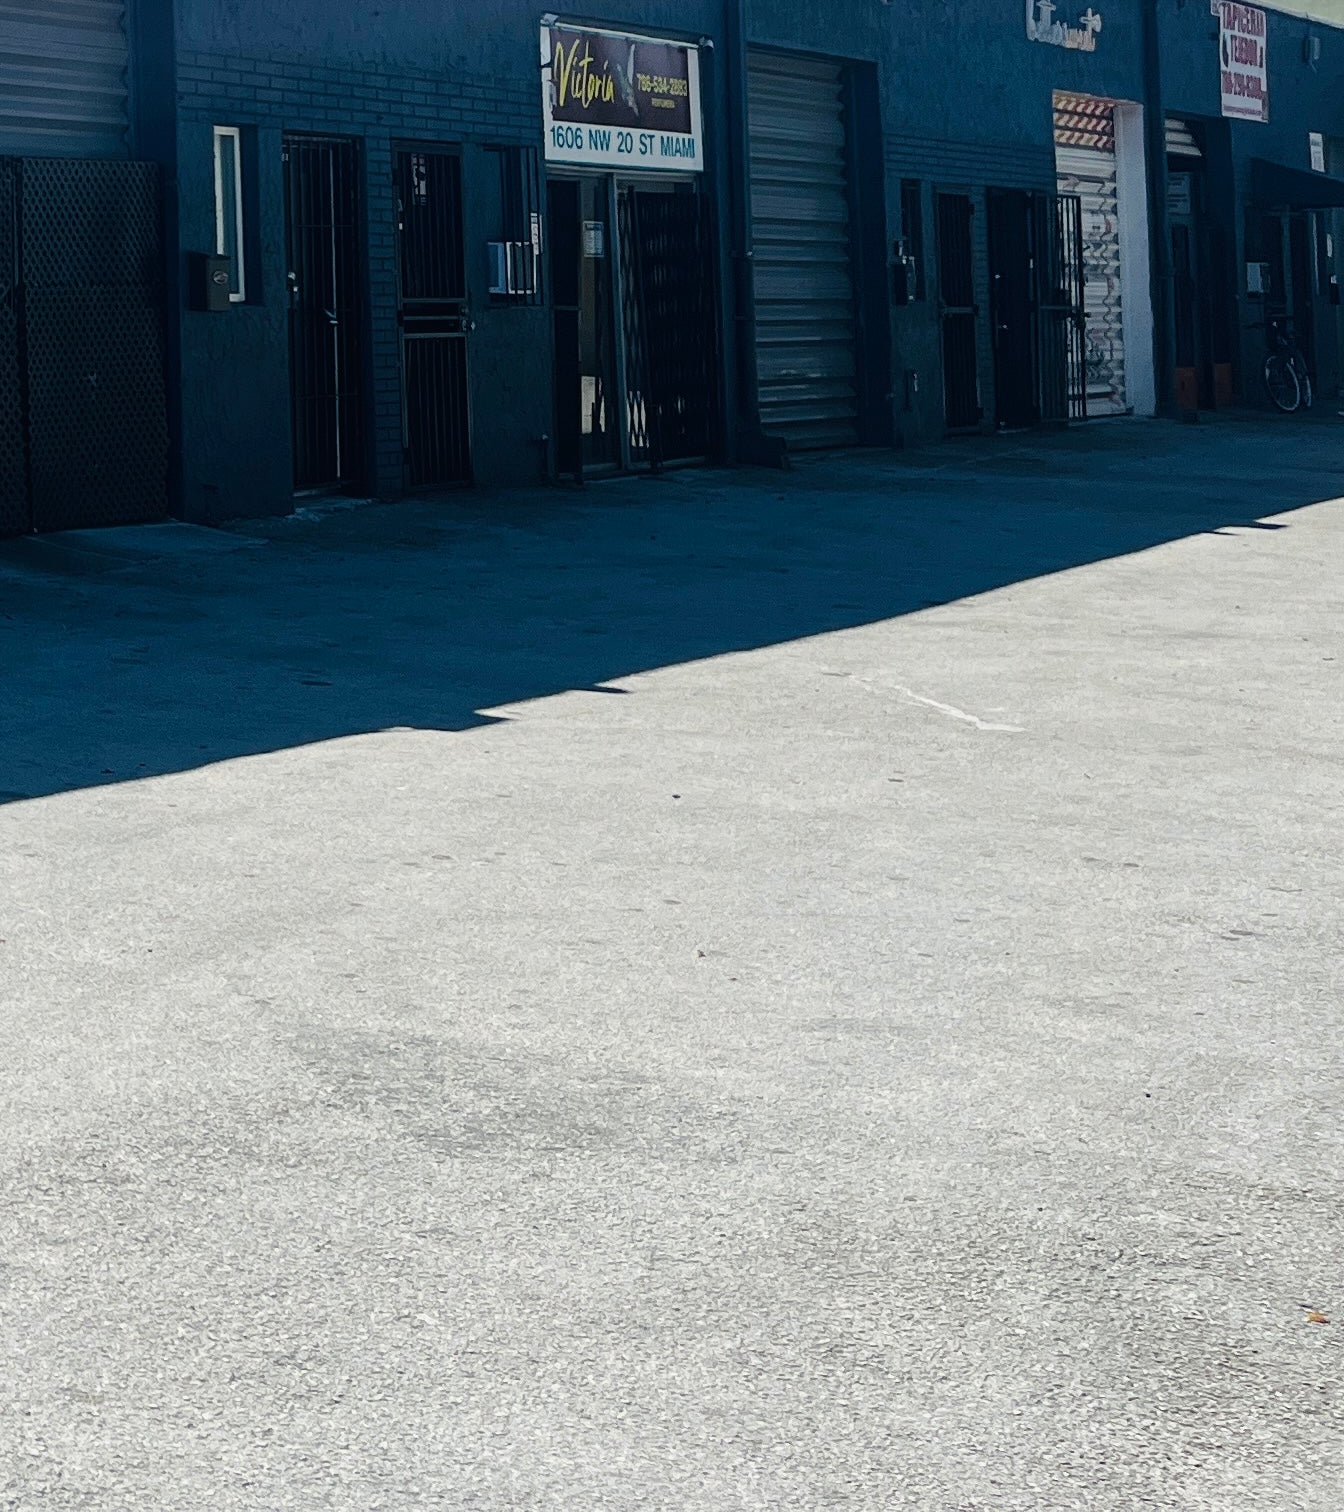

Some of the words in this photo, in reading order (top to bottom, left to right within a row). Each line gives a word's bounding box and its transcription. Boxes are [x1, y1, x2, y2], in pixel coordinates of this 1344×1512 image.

[554, 38, 615, 108] Victoria
[551, 125, 584, 149] 1606
[588, 129, 612, 152] NW
[617, 131, 633, 154] 20
[639, 133, 656, 156] ST
[660, 135, 696, 159] MIAMI
